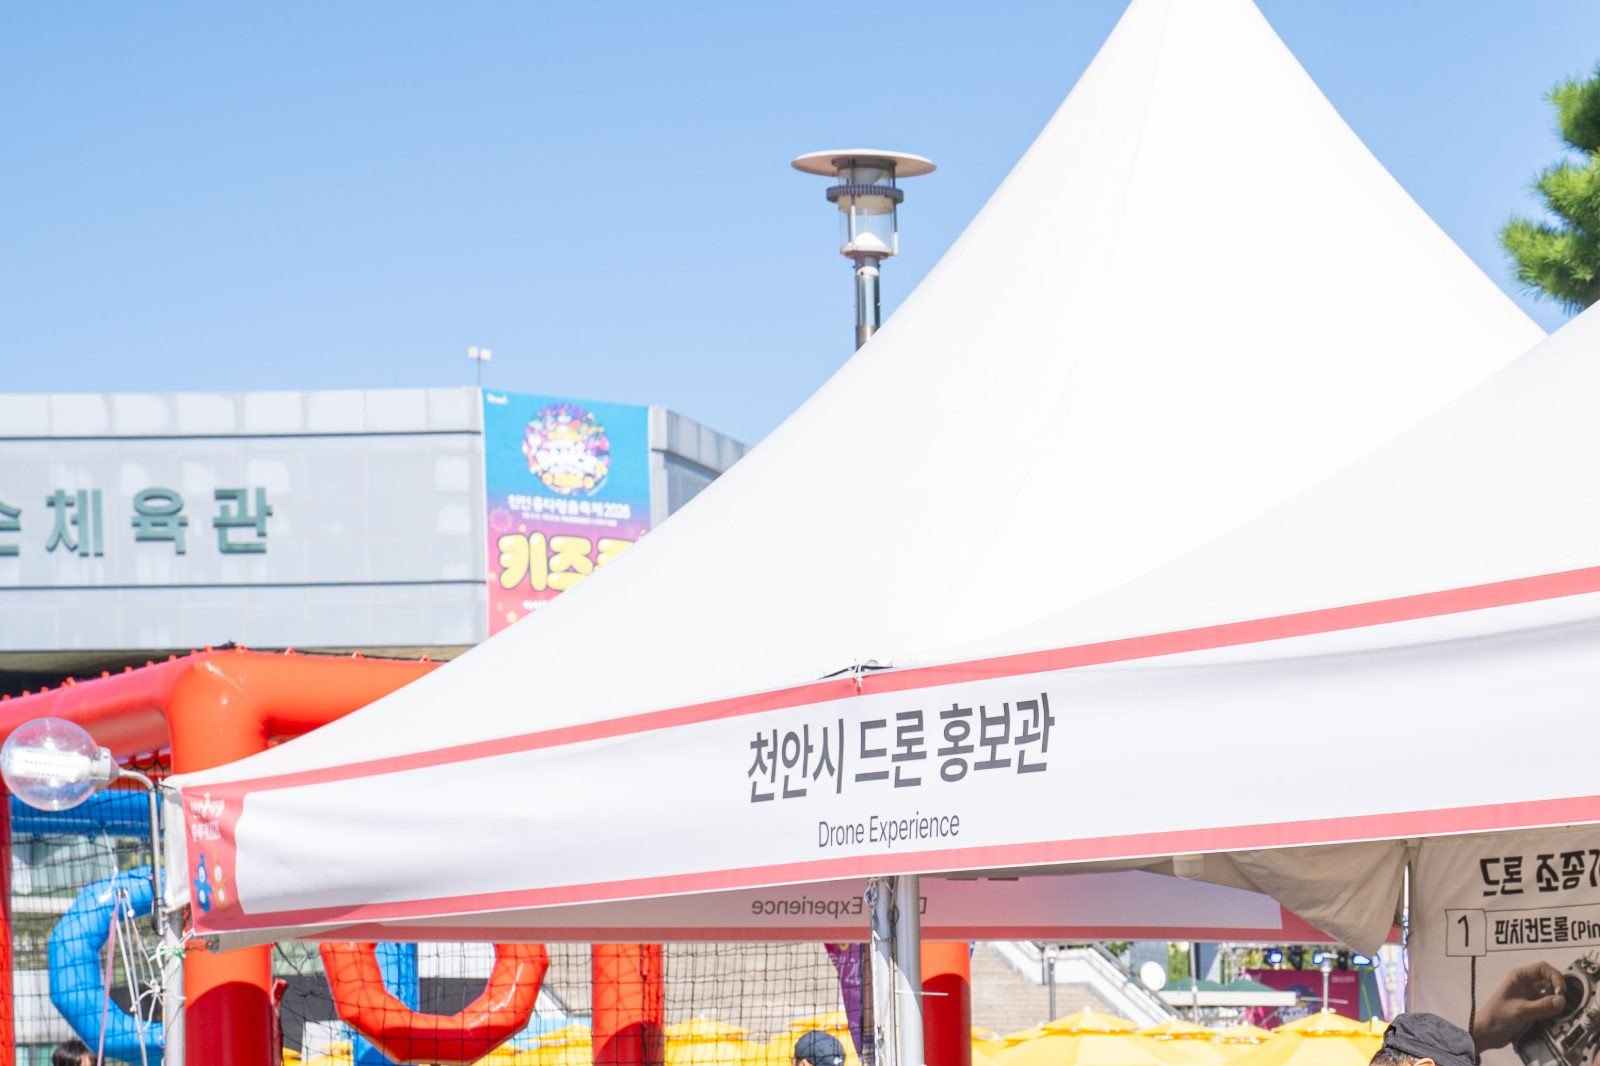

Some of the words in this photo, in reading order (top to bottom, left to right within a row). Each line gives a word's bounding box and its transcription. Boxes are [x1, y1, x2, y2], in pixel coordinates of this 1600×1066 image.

[748, 718, 844, 803] 천안시
[855, 709, 927, 788] 드론
[937, 692, 1055, 782] 홍보관
[819, 821, 864, 848] Drone
[869, 811, 960, 848] Experience
[1480, 855, 1524, 896] 드론
[1458, 915, 1470, 947] 1
